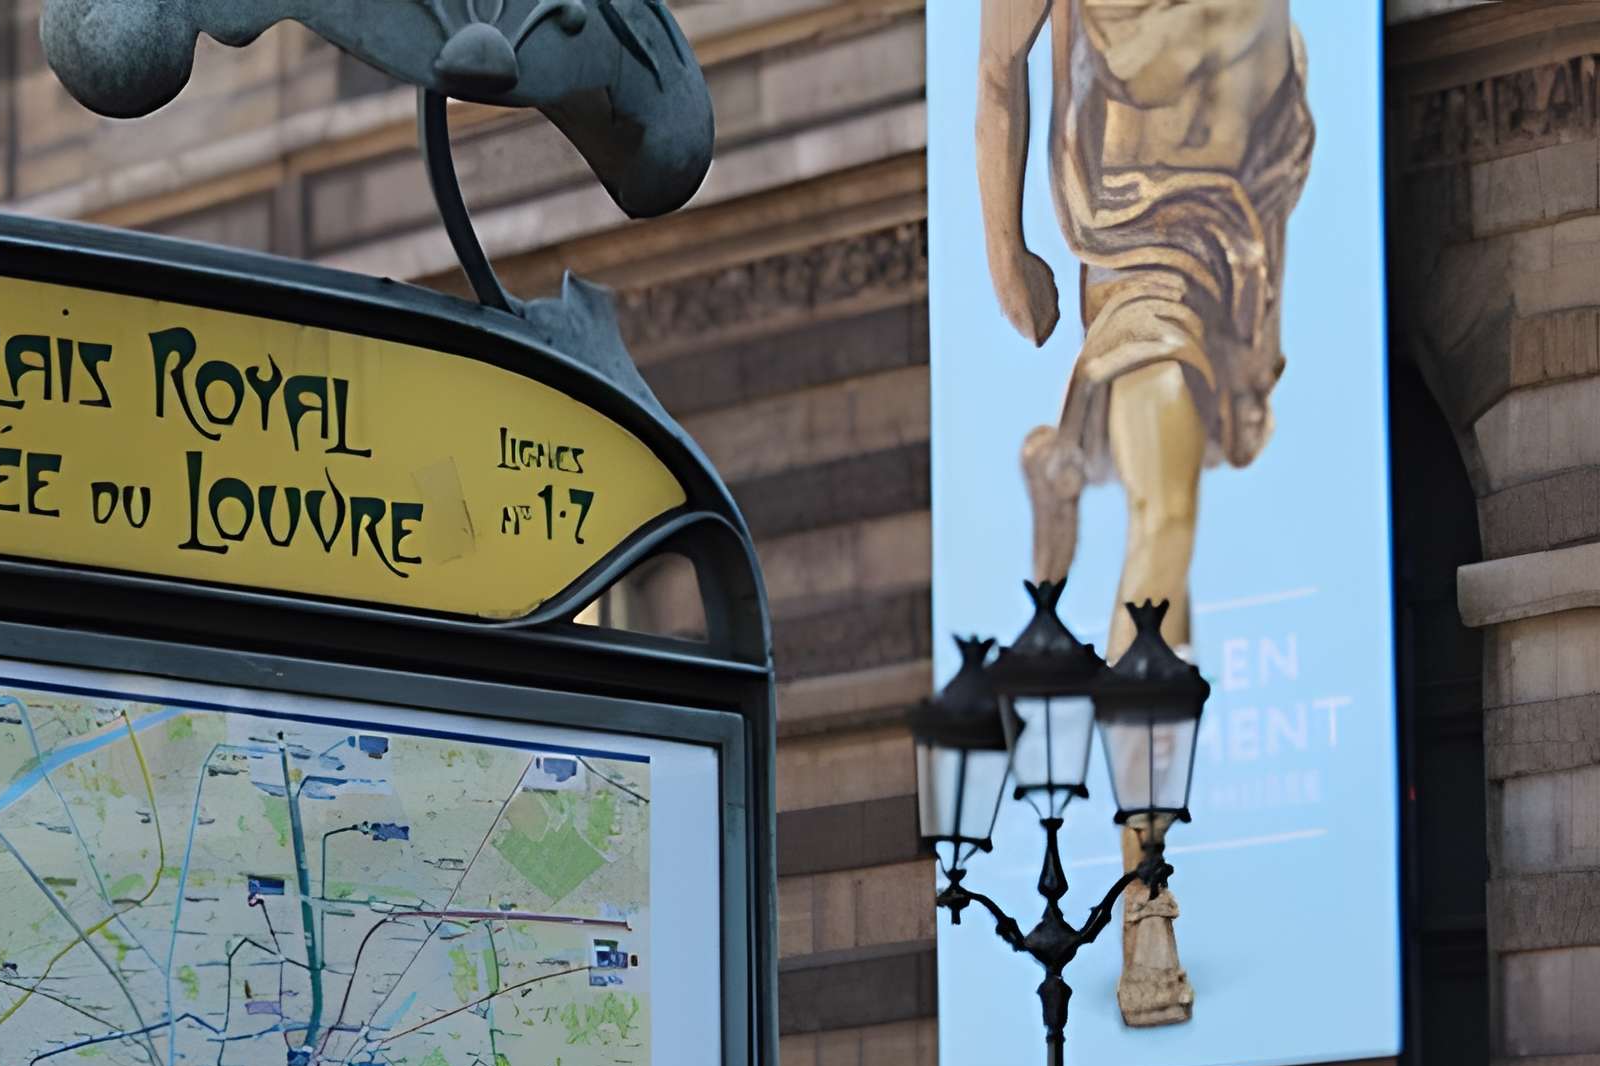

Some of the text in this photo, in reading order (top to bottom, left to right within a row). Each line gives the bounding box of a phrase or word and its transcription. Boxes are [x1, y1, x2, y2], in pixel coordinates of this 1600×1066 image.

[148, 326, 372, 458] ROYAL
[497, 427, 585, 474] LIGNES
[90, 481, 151, 529] DU
[177, 450, 425, 579] LOUVRE
[1221, 630, 1301, 693] EN
